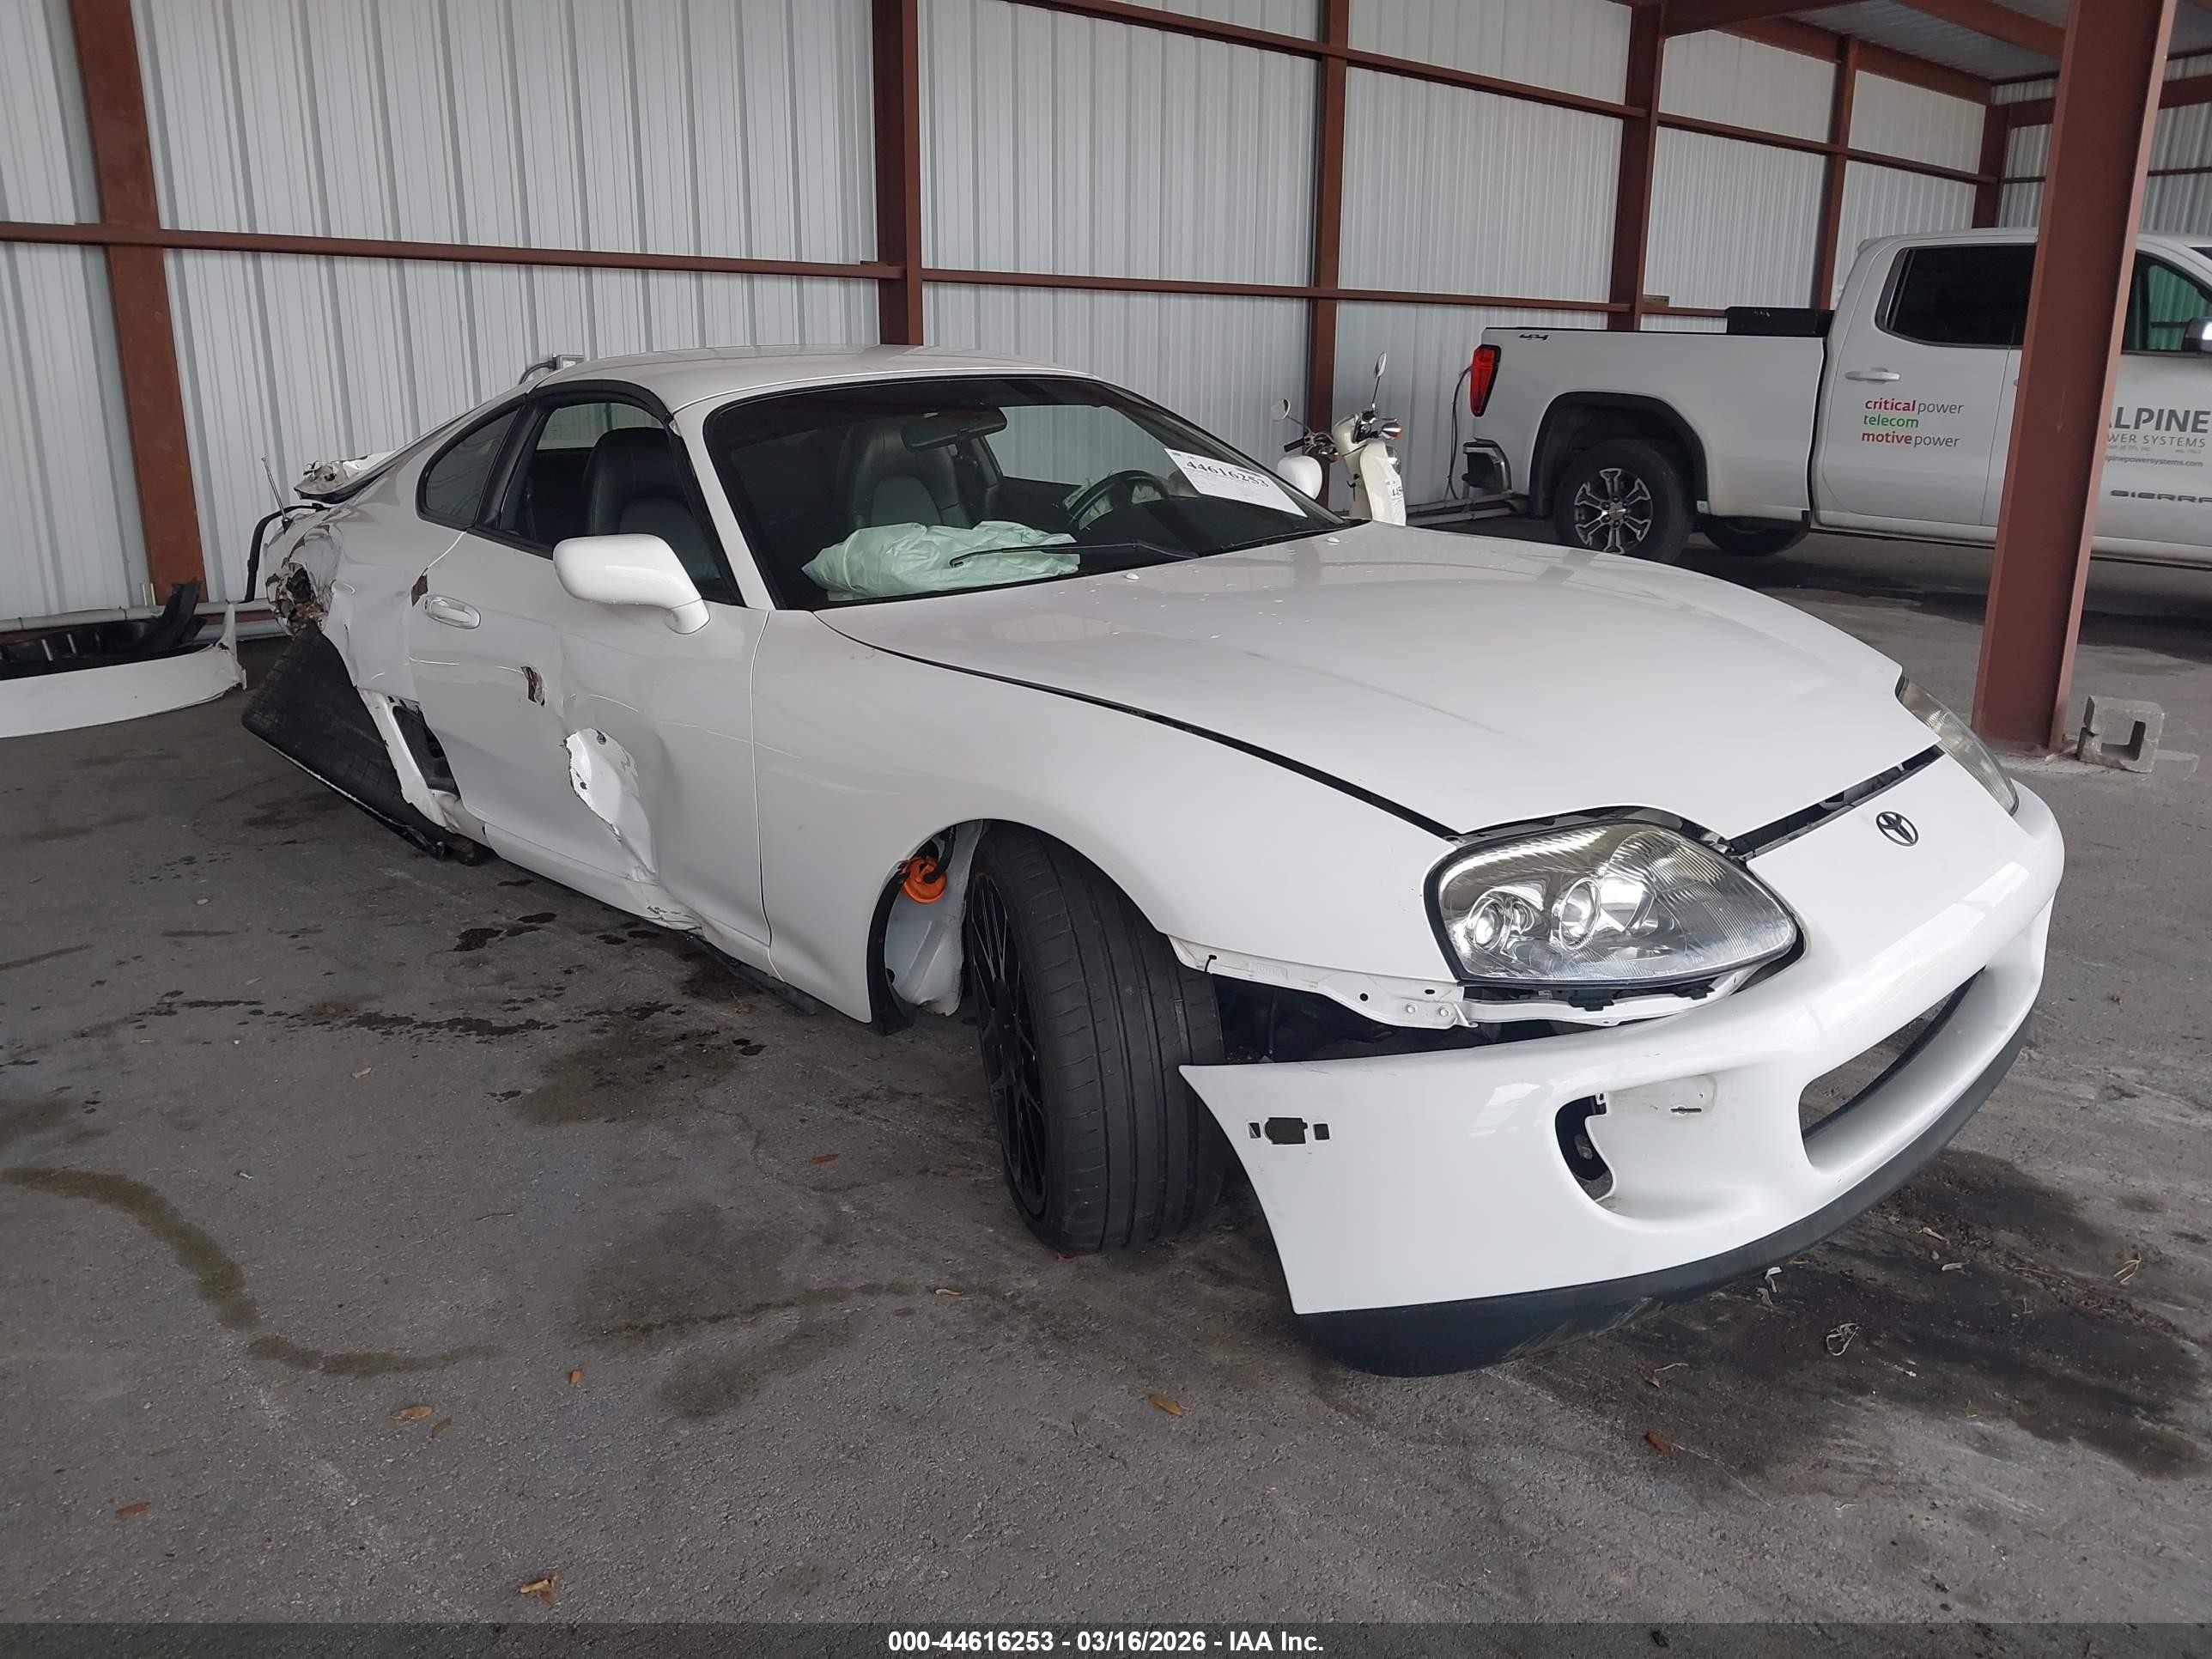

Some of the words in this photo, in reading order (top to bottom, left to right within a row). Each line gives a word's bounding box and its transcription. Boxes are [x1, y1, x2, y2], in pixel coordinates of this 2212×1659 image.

[1863, 414, 1919, 428] telecom
[2109, 406, 2212, 434] LPINE
[2142, 434, 2206, 447] SYSTEMS
[1187, 461, 1270, 488] 44616253
[2111, 489, 2212, 503] SIERRA
